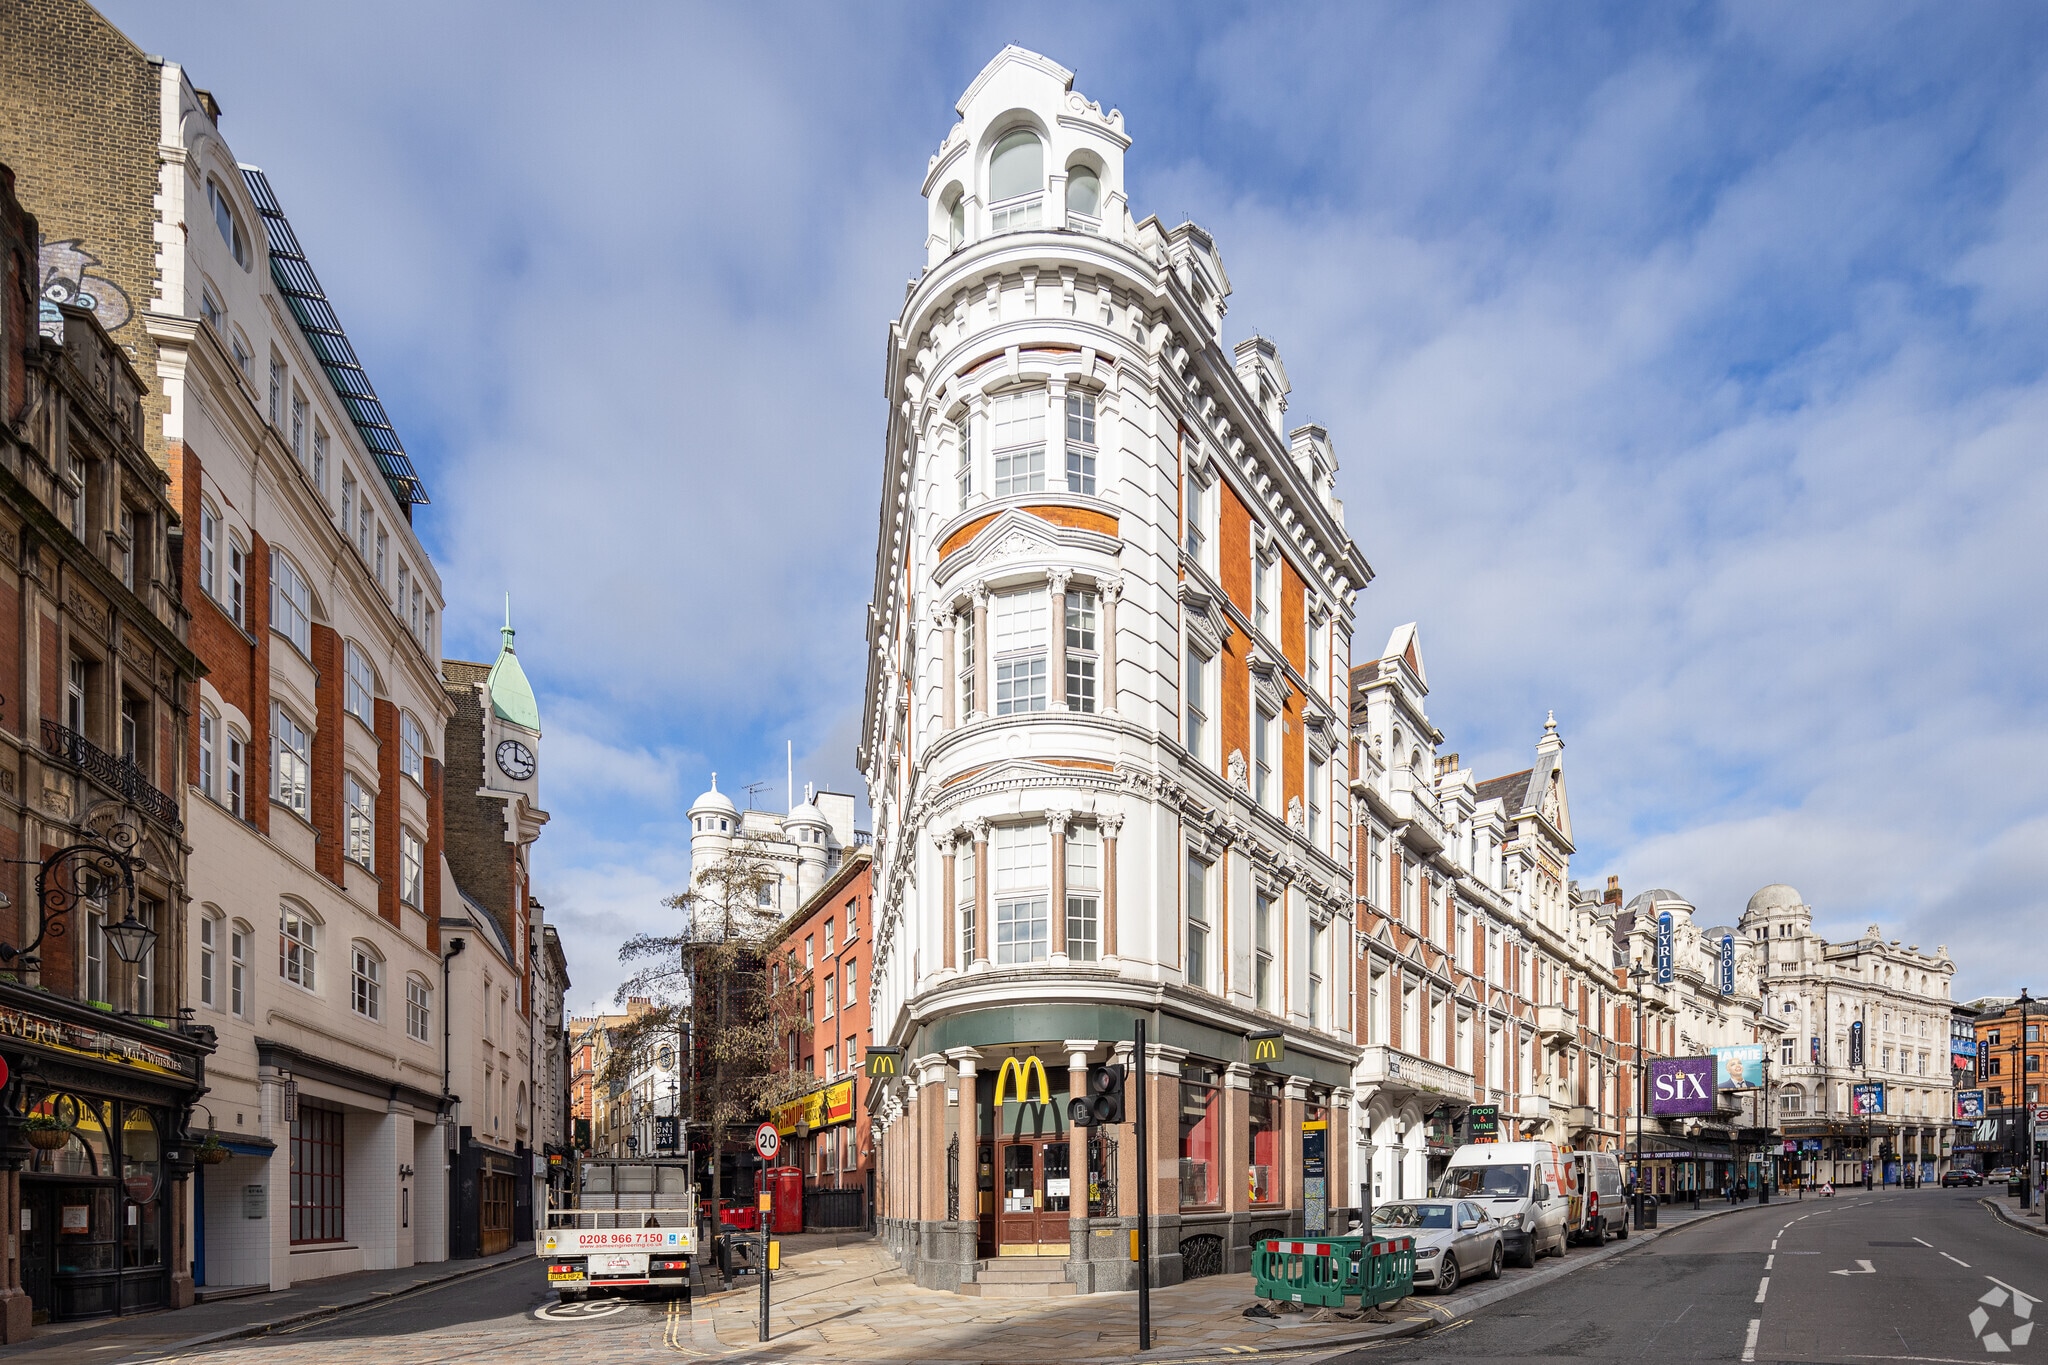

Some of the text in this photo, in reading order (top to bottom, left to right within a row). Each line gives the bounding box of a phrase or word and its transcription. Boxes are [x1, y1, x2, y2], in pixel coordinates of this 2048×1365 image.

[1660, 924, 1670, 979] LYRIC
[1722, 942, 1732, 992] APOLLO
[122, 1046, 182, 1071] MALT WHISKIES
[1472, 1108, 1495, 1116] FOOD
[1479, 1115, 1486, 1123] &
[760, 1133, 777, 1149] 20
[579, 1233, 663, 1244] 0208 966 7150
